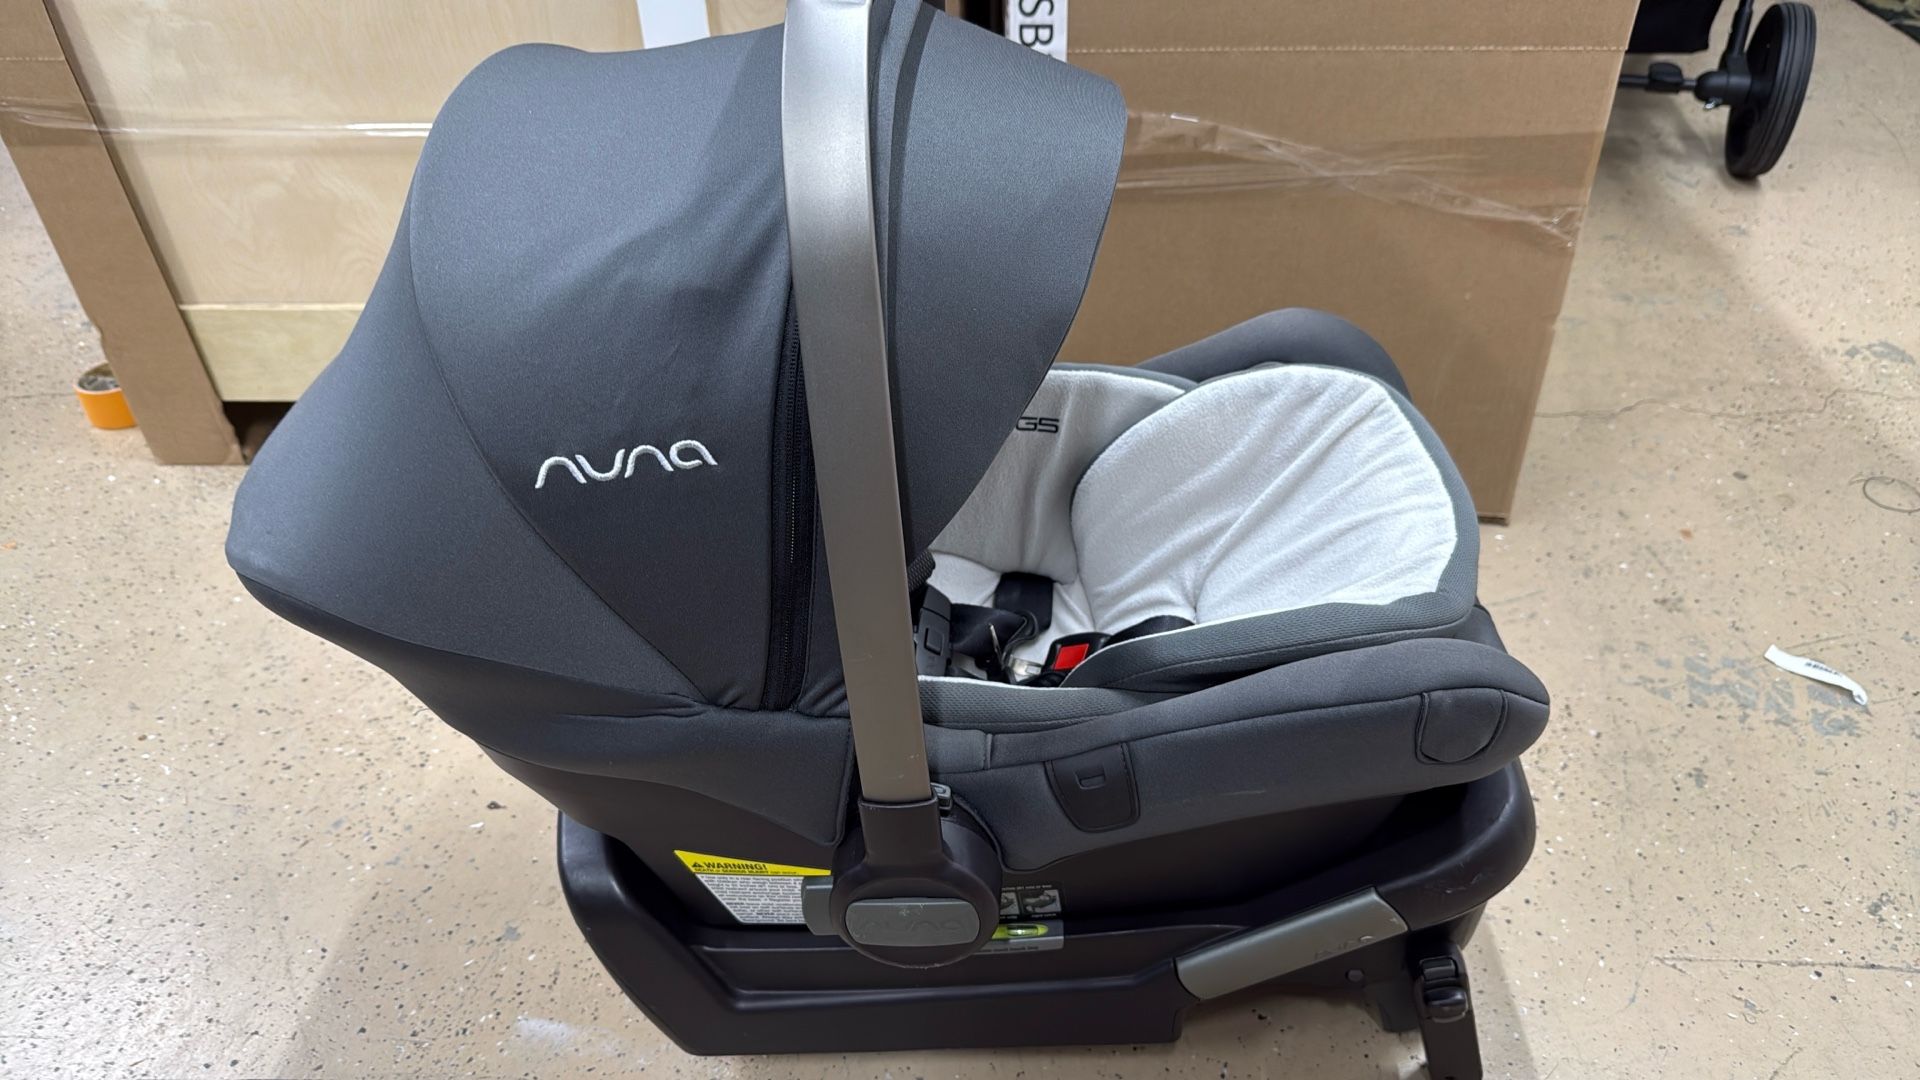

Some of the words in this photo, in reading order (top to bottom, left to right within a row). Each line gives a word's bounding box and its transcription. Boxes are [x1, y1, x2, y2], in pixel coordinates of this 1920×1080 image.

[1019, 0, 1055, 53] SB
[534, 439, 719, 489] nuna
[704, 862, 767, 871] WARNING!
